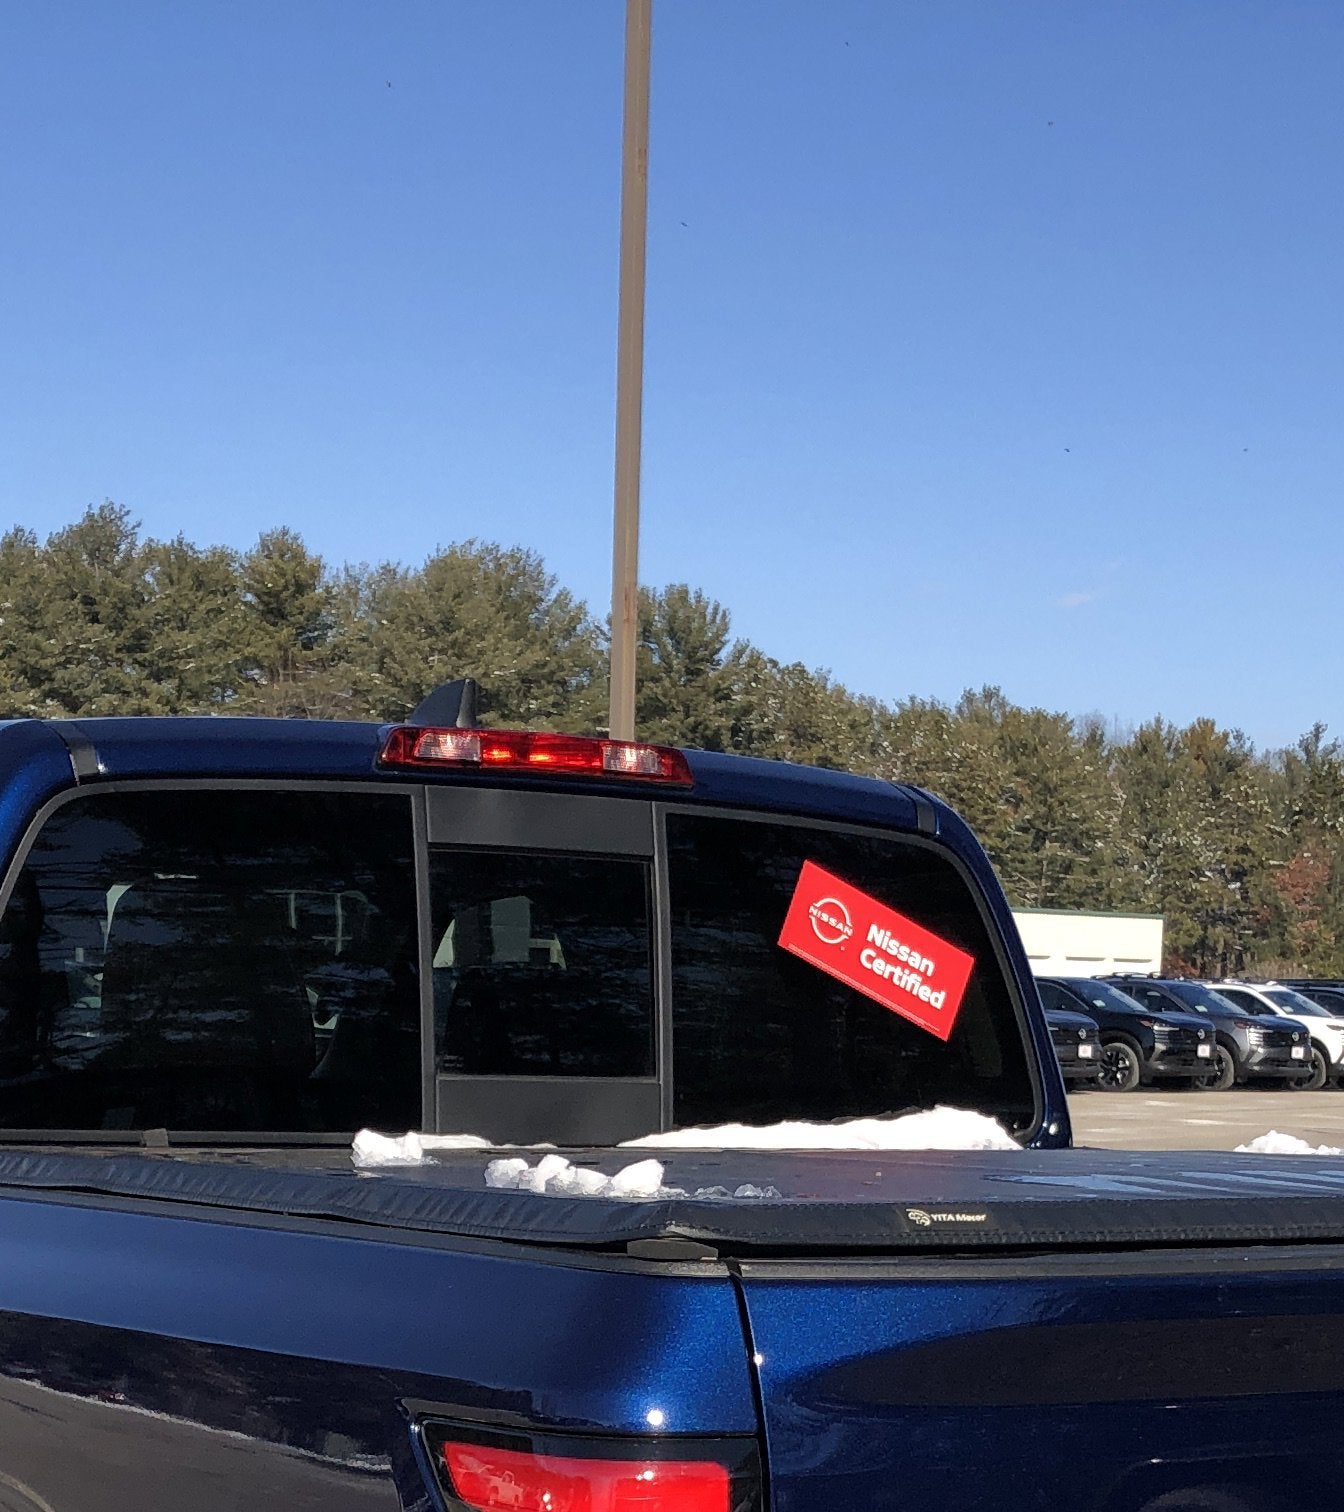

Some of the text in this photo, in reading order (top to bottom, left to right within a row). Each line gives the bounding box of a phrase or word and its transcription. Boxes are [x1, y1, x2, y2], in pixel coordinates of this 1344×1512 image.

[808, 905, 854, 937] NISSAN
[866, 924, 935, 977] Nissan
[860, 948, 946, 1010] Certified
